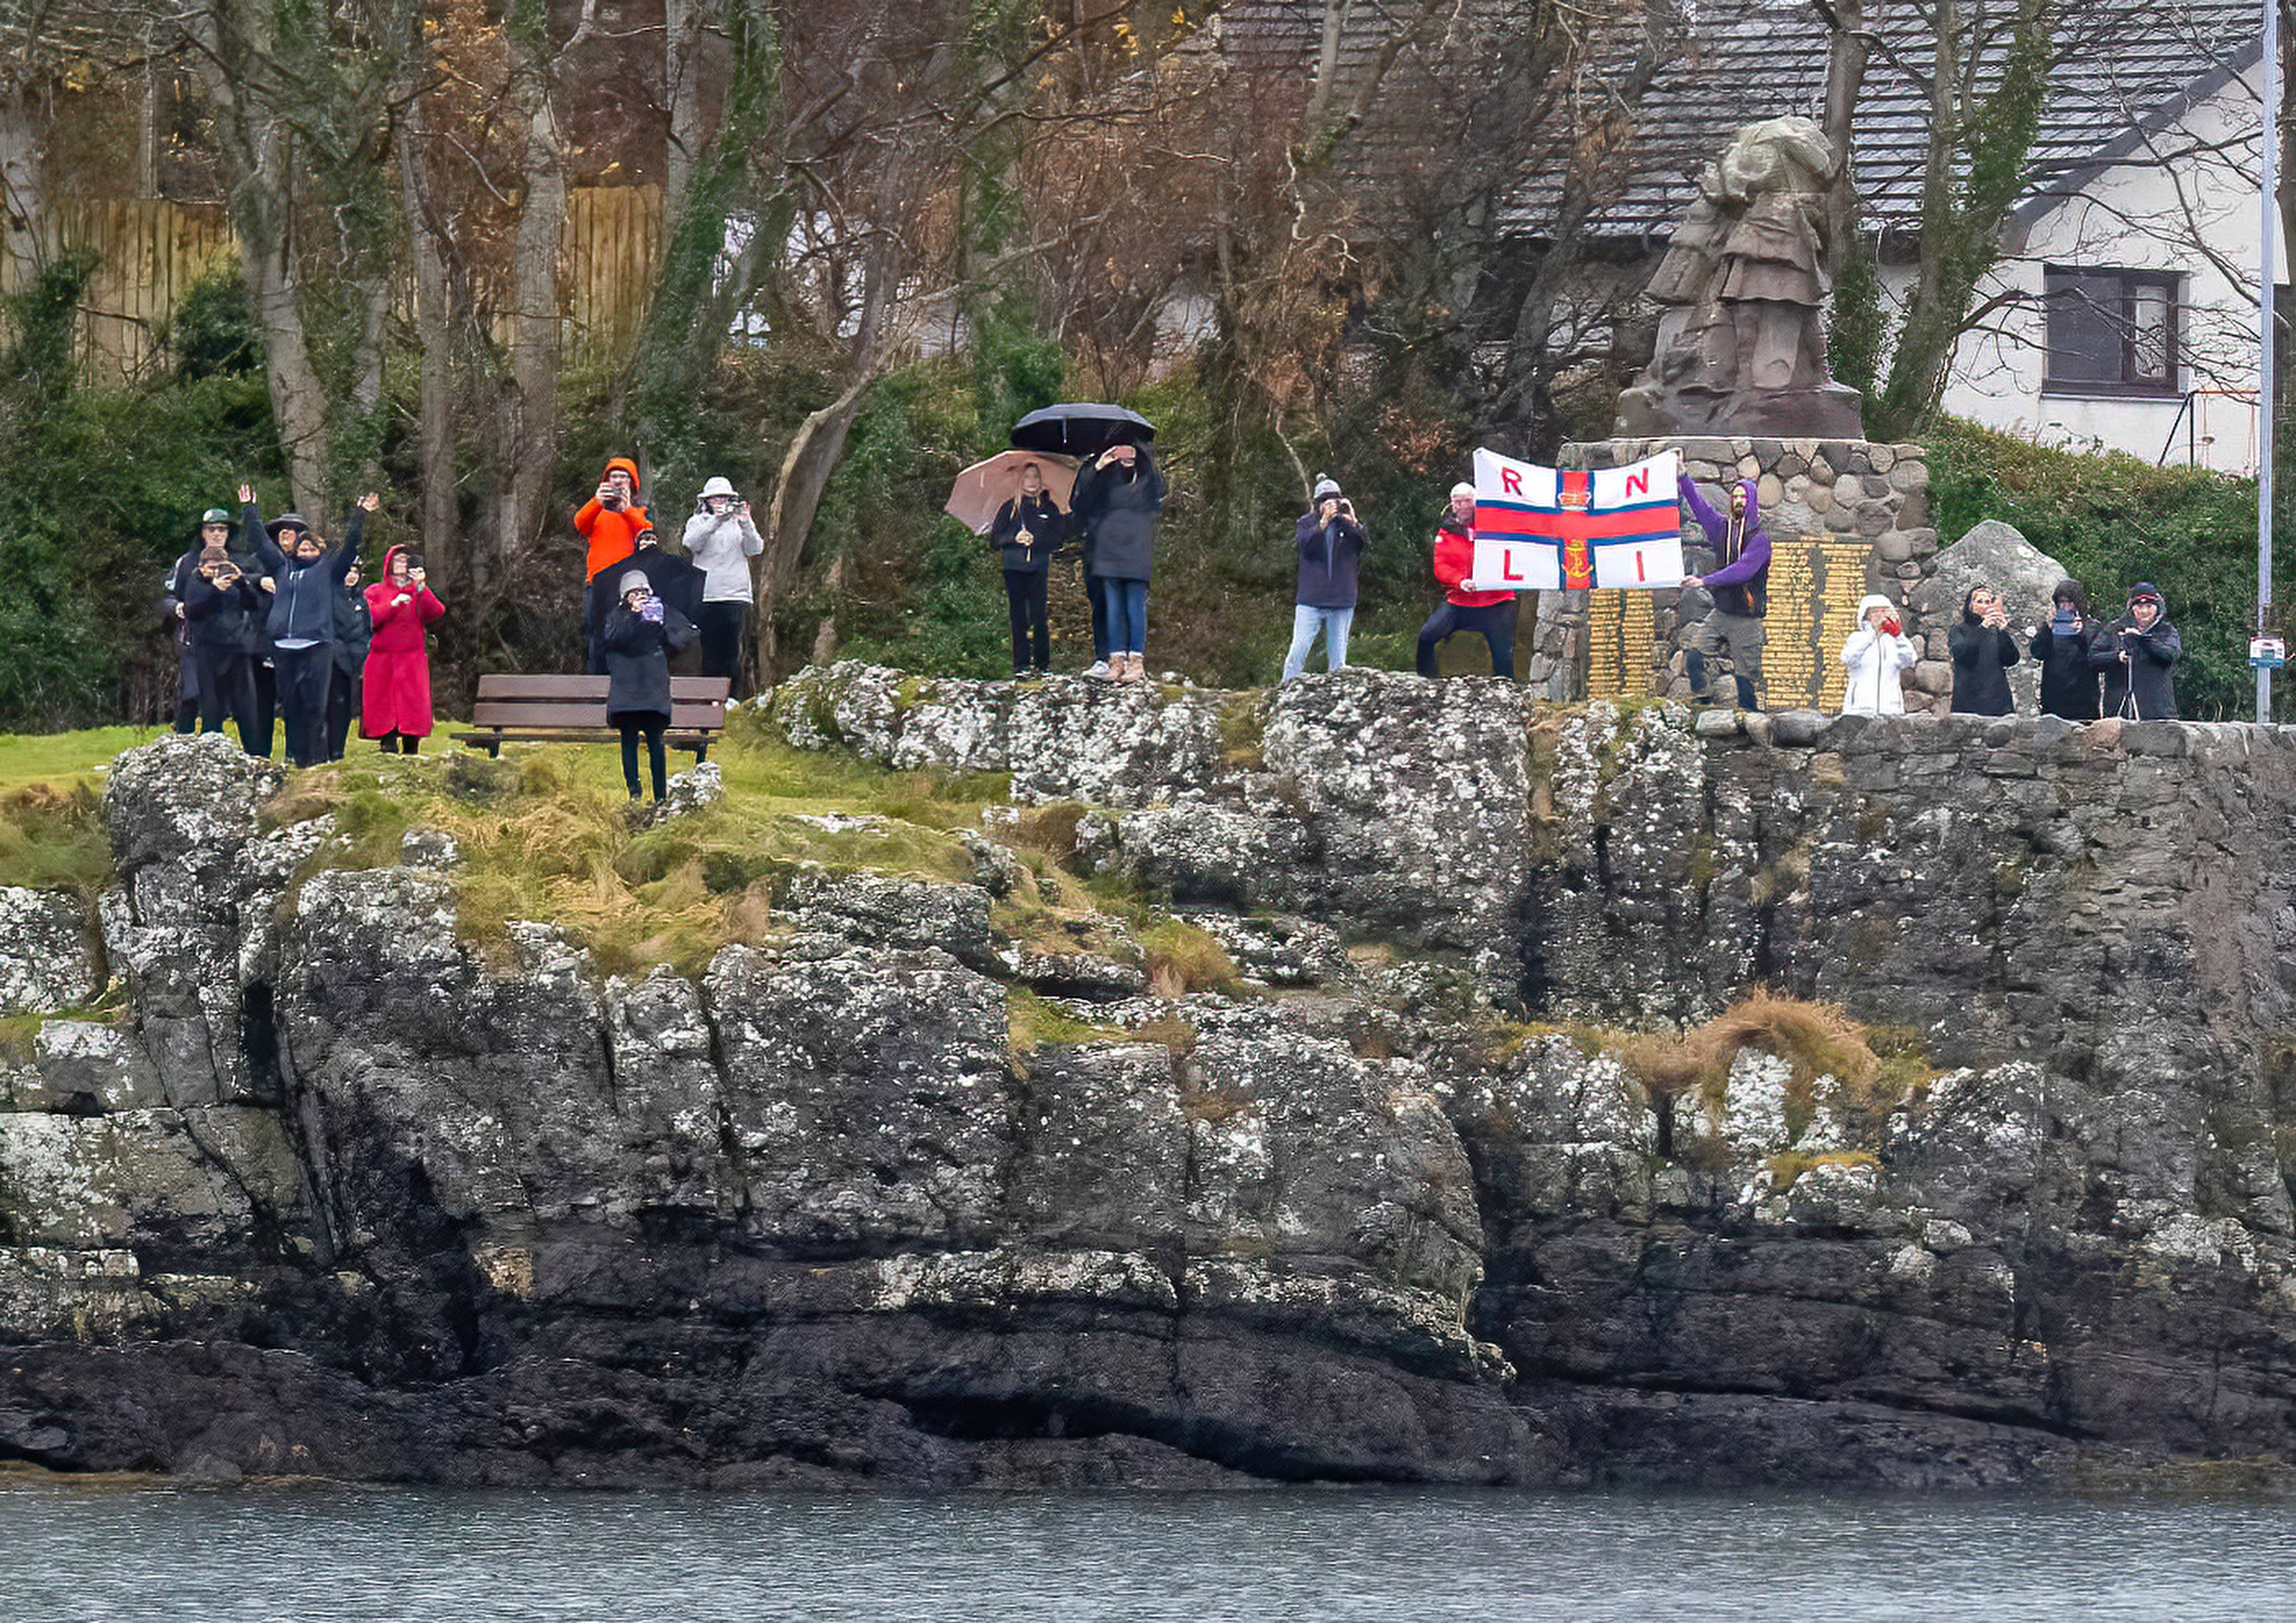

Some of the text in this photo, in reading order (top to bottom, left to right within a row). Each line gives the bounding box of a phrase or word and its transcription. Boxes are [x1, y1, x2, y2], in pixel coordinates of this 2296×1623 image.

[1501, 467, 1649, 499] R N
[1503, 548, 1645, 582] L I
